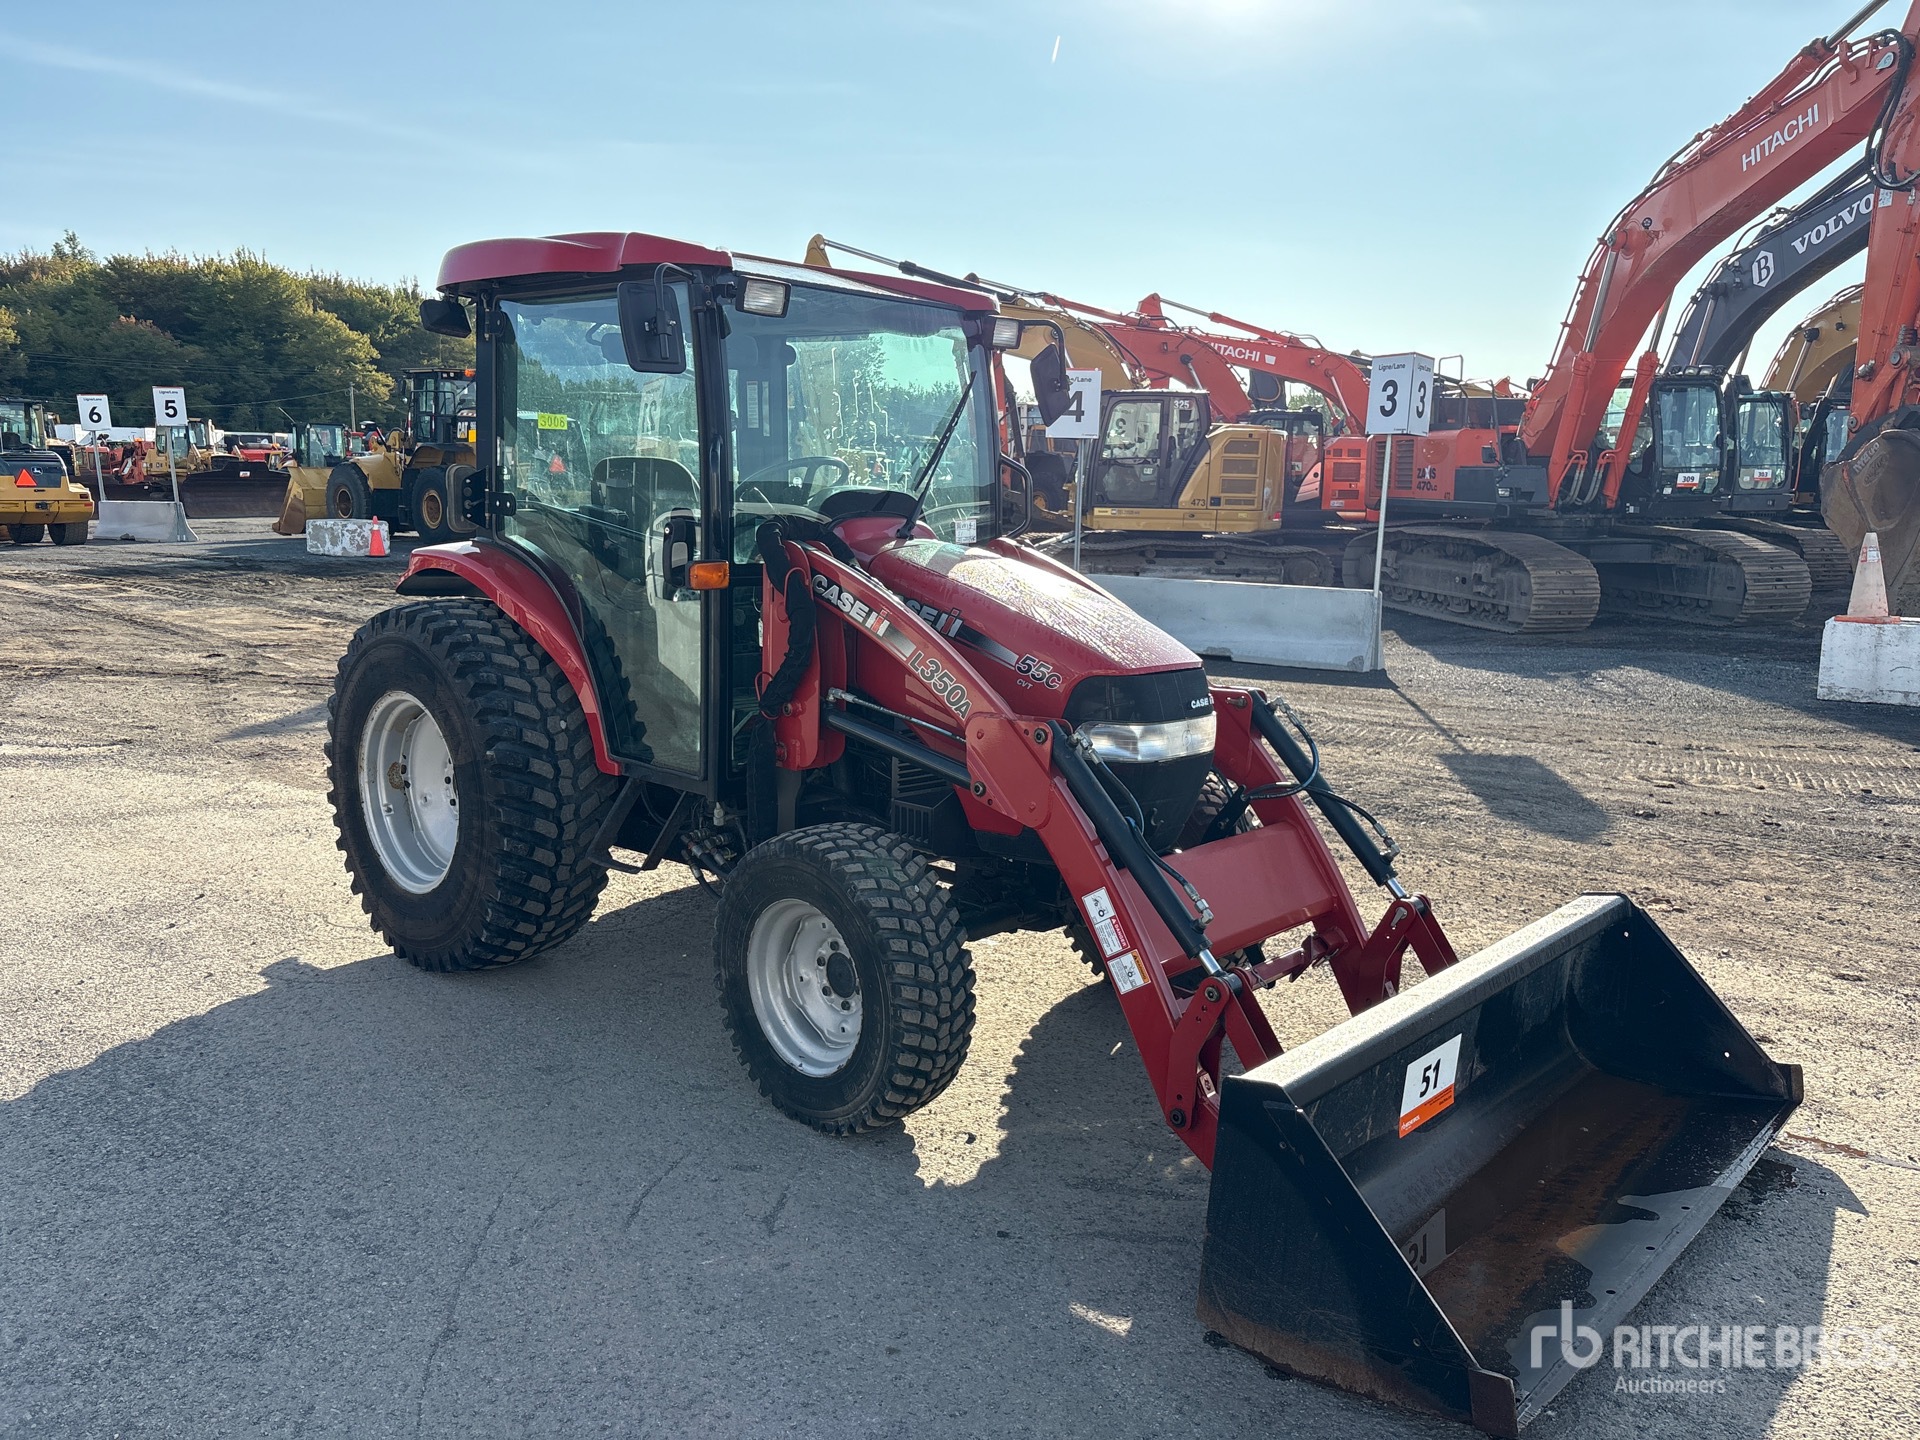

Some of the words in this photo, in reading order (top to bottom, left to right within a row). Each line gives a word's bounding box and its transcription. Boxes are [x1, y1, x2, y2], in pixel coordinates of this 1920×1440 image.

[1742, 104, 1818, 171] HITACHI
[1791, 194, 1874, 254] VOLVO
[1379, 363, 1405, 371] Ligne/Lane
[165, 400, 177, 418] 5
[1063, 391, 1084, 422] 4
[1380, 380, 1398, 417] 3
[1416, 381, 1426, 418] 3
[89, 406, 102, 423] 6
[457, 422, 468, 438] CAT
[1417, 465, 1436, 479] ZAXIS
[812, 574, 869, 623] CASE
[908, 650, 973, 719] L350A
[1015, 653, 1062, 689] 55C
[1016, 678, 1033, 690] CVT
[1191, 697, 1209, 708] CASE
[1114, 924, 1126, 947] DANGER
[1419, 1058, 1441, 1098] 51
